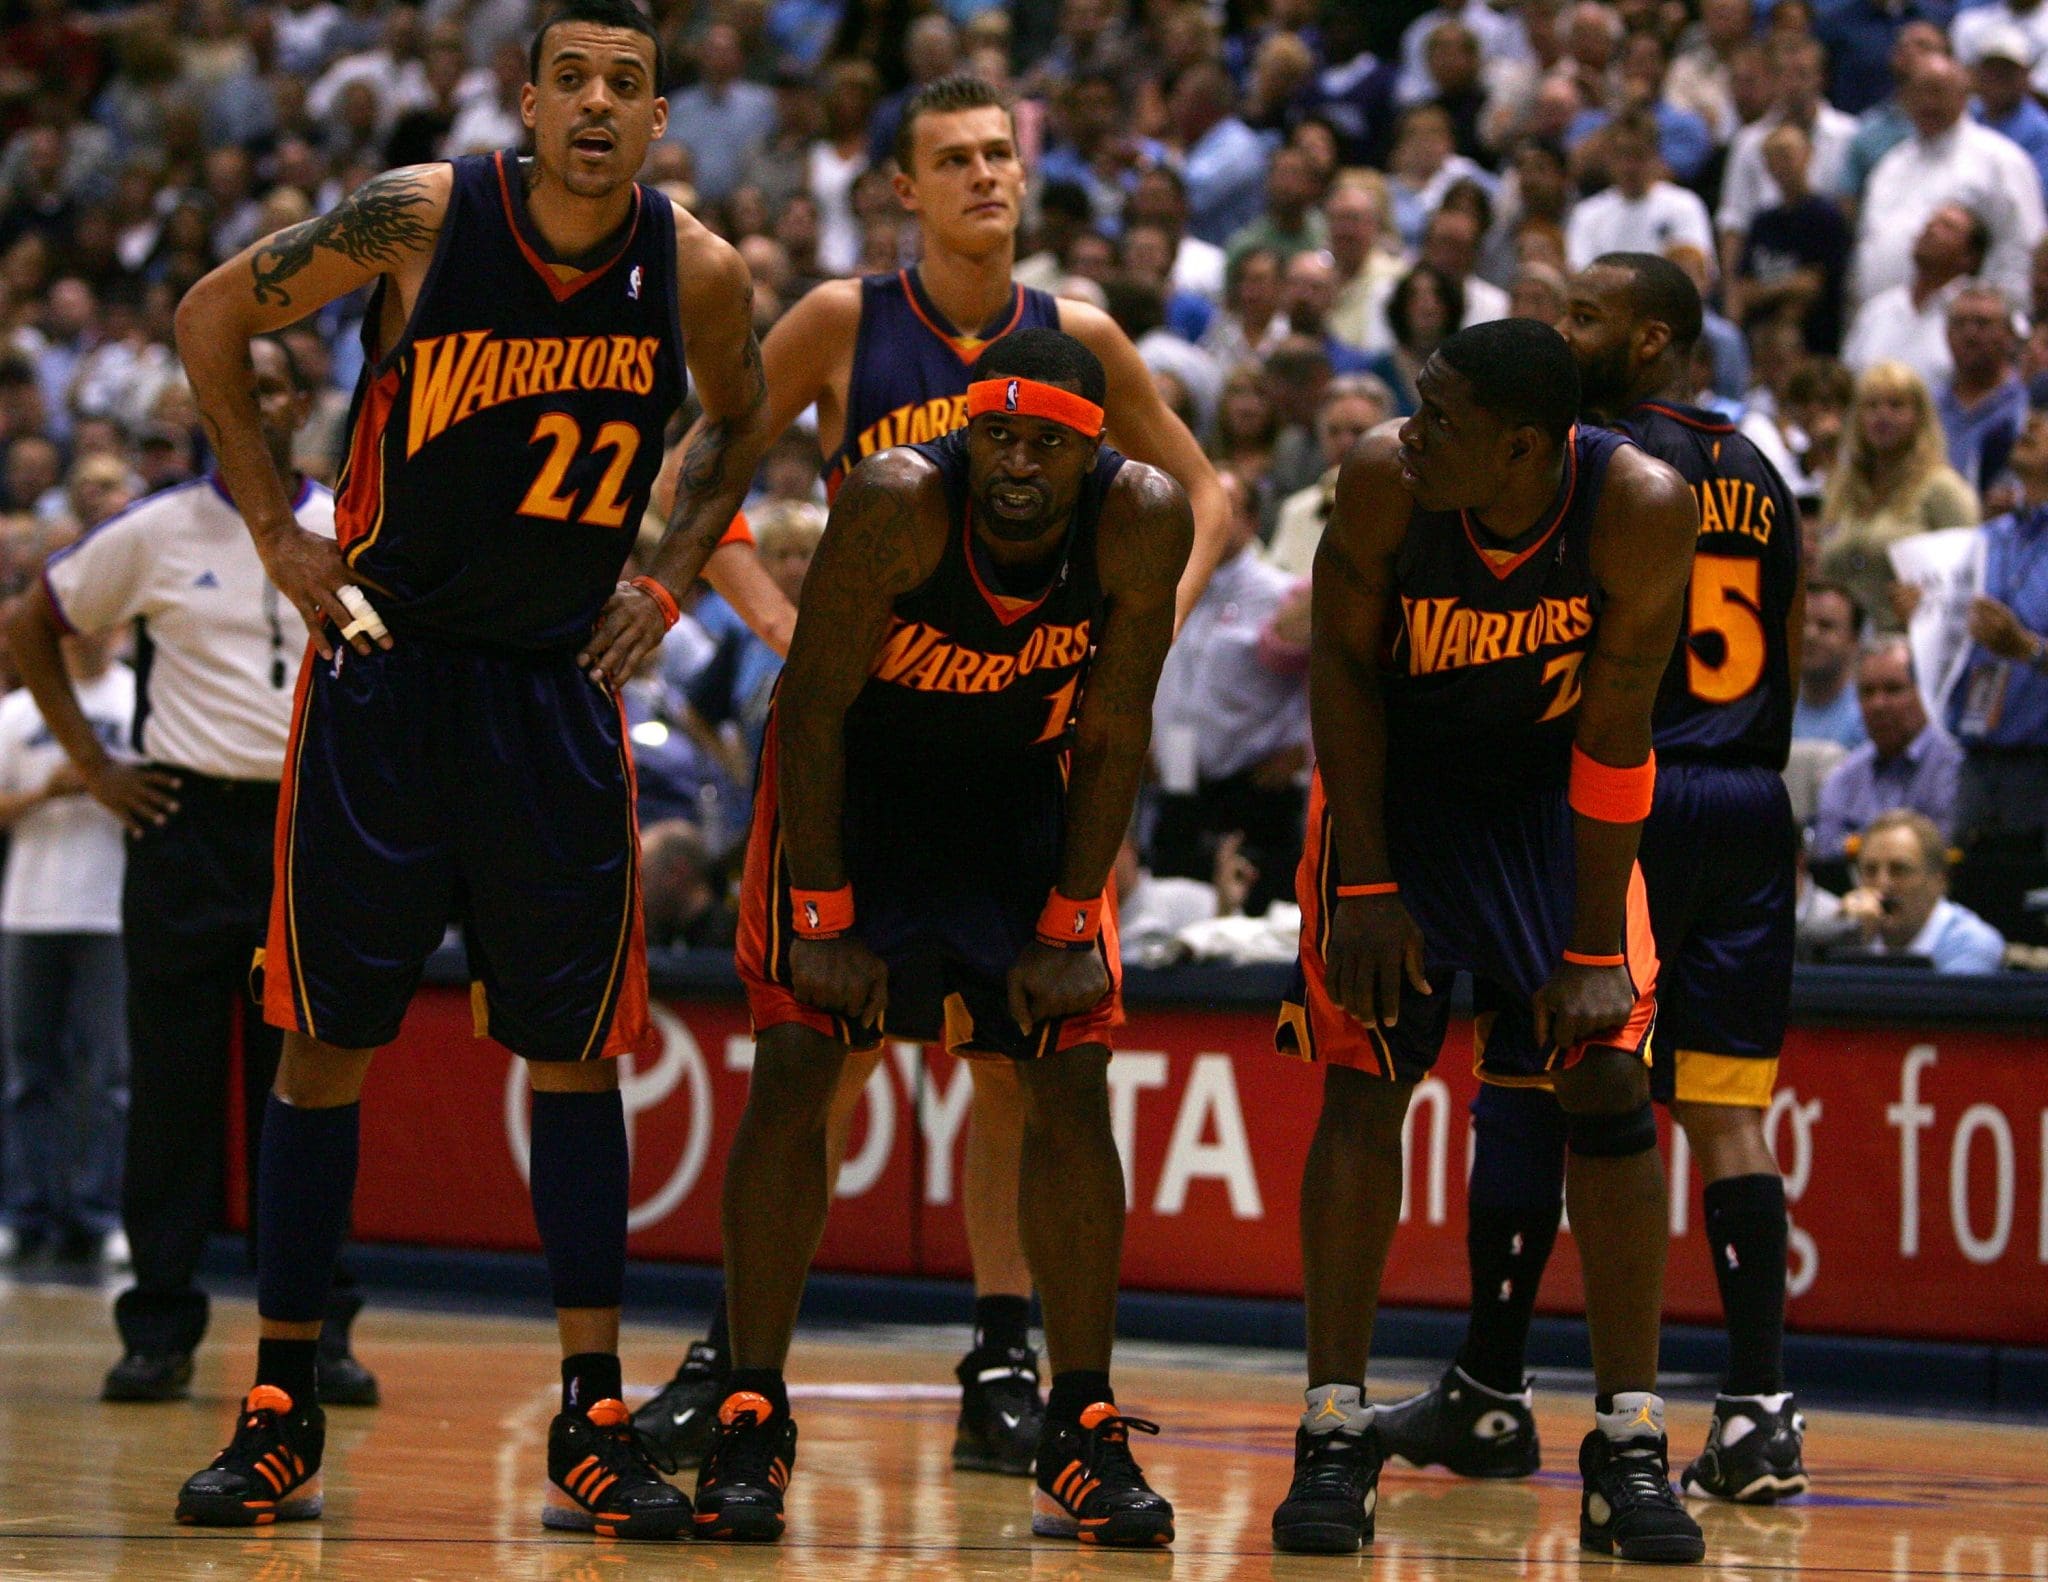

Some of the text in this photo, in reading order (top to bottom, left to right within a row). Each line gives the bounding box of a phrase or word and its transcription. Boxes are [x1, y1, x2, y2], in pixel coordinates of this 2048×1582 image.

[406, 328, 661, 462] WARRIORS
[857, 391, 969, 458] WARR
[515, 411, 641, 528] 22
[1689, 478, 1776, 545] AVIS
[1685, 550, 1767, 704] 5
[724, 1034, 1265, 1220] OYTA
[1886, 1043, 2048, 1267] fo
